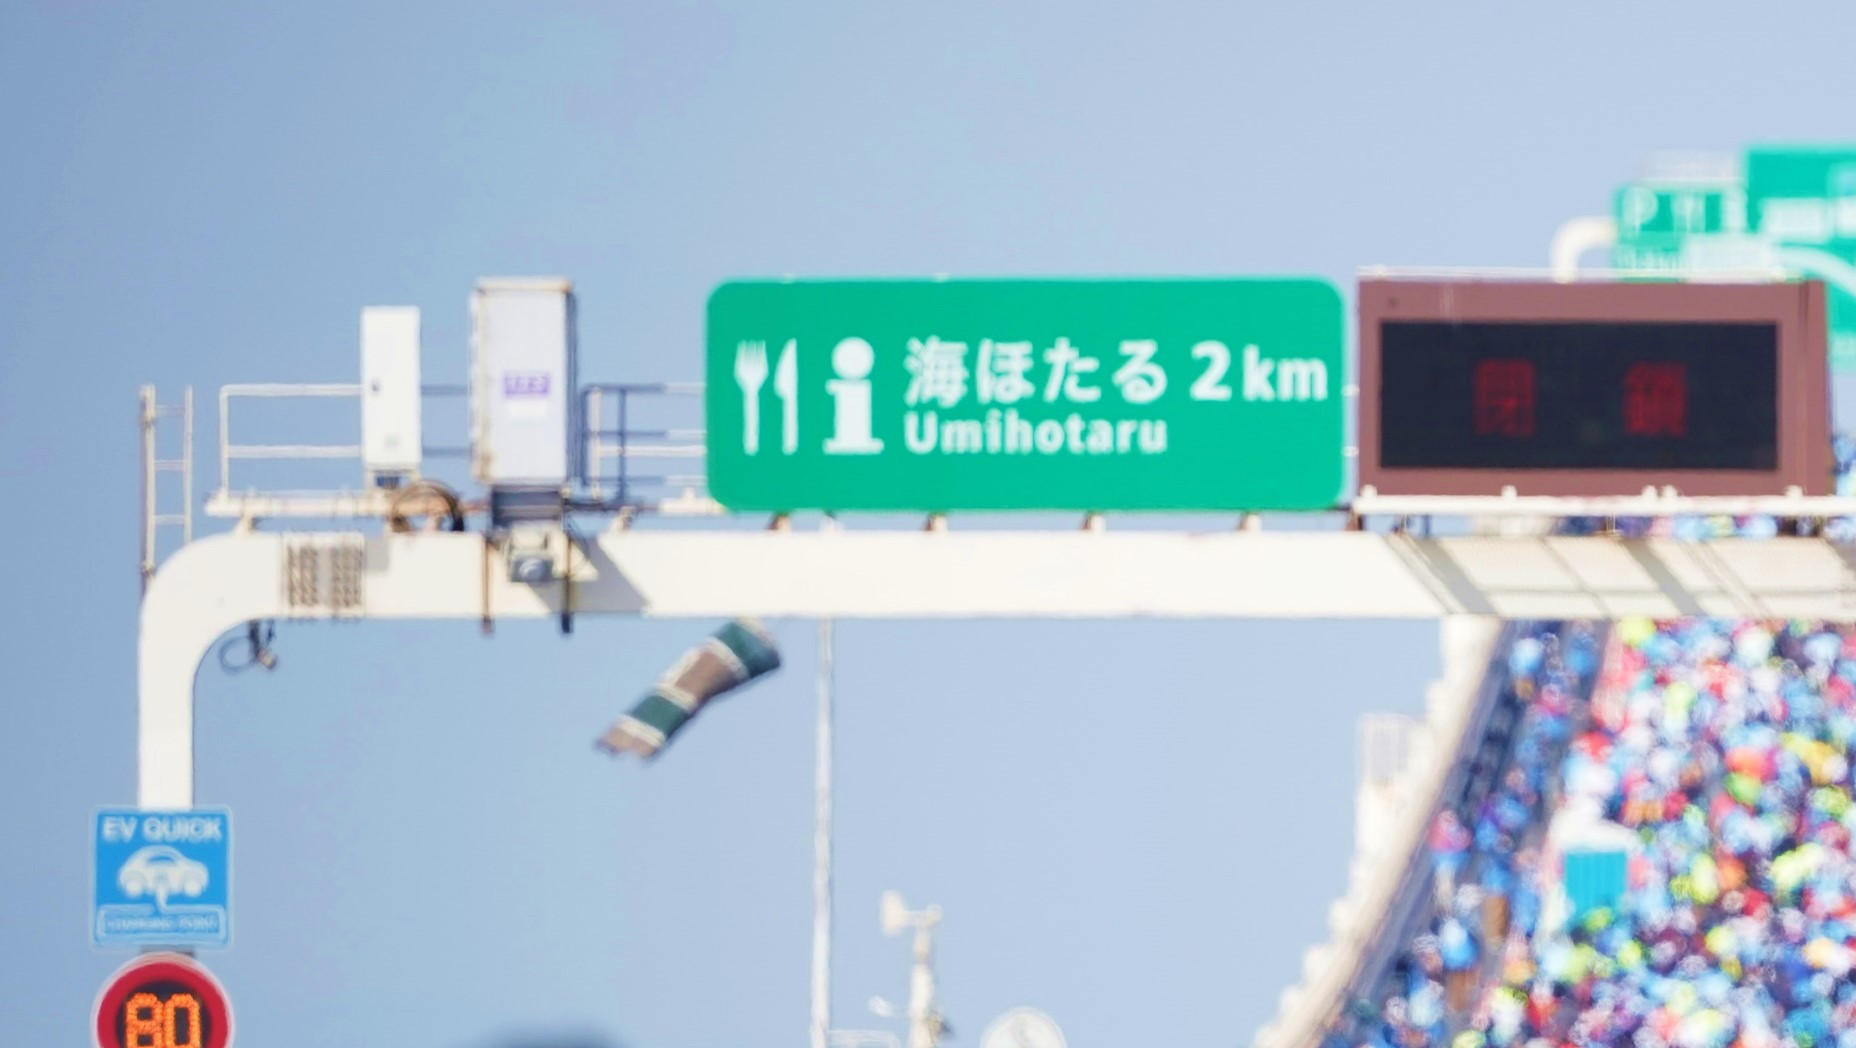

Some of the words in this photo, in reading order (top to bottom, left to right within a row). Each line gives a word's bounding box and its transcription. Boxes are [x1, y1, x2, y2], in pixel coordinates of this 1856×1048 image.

[904, 336, 1167, 406] 海ほたる
[904, 408, 1168, 456] Umihotaru
[103, 816, 137, 841] EV
[143, 816, 222, 842] QUICK
